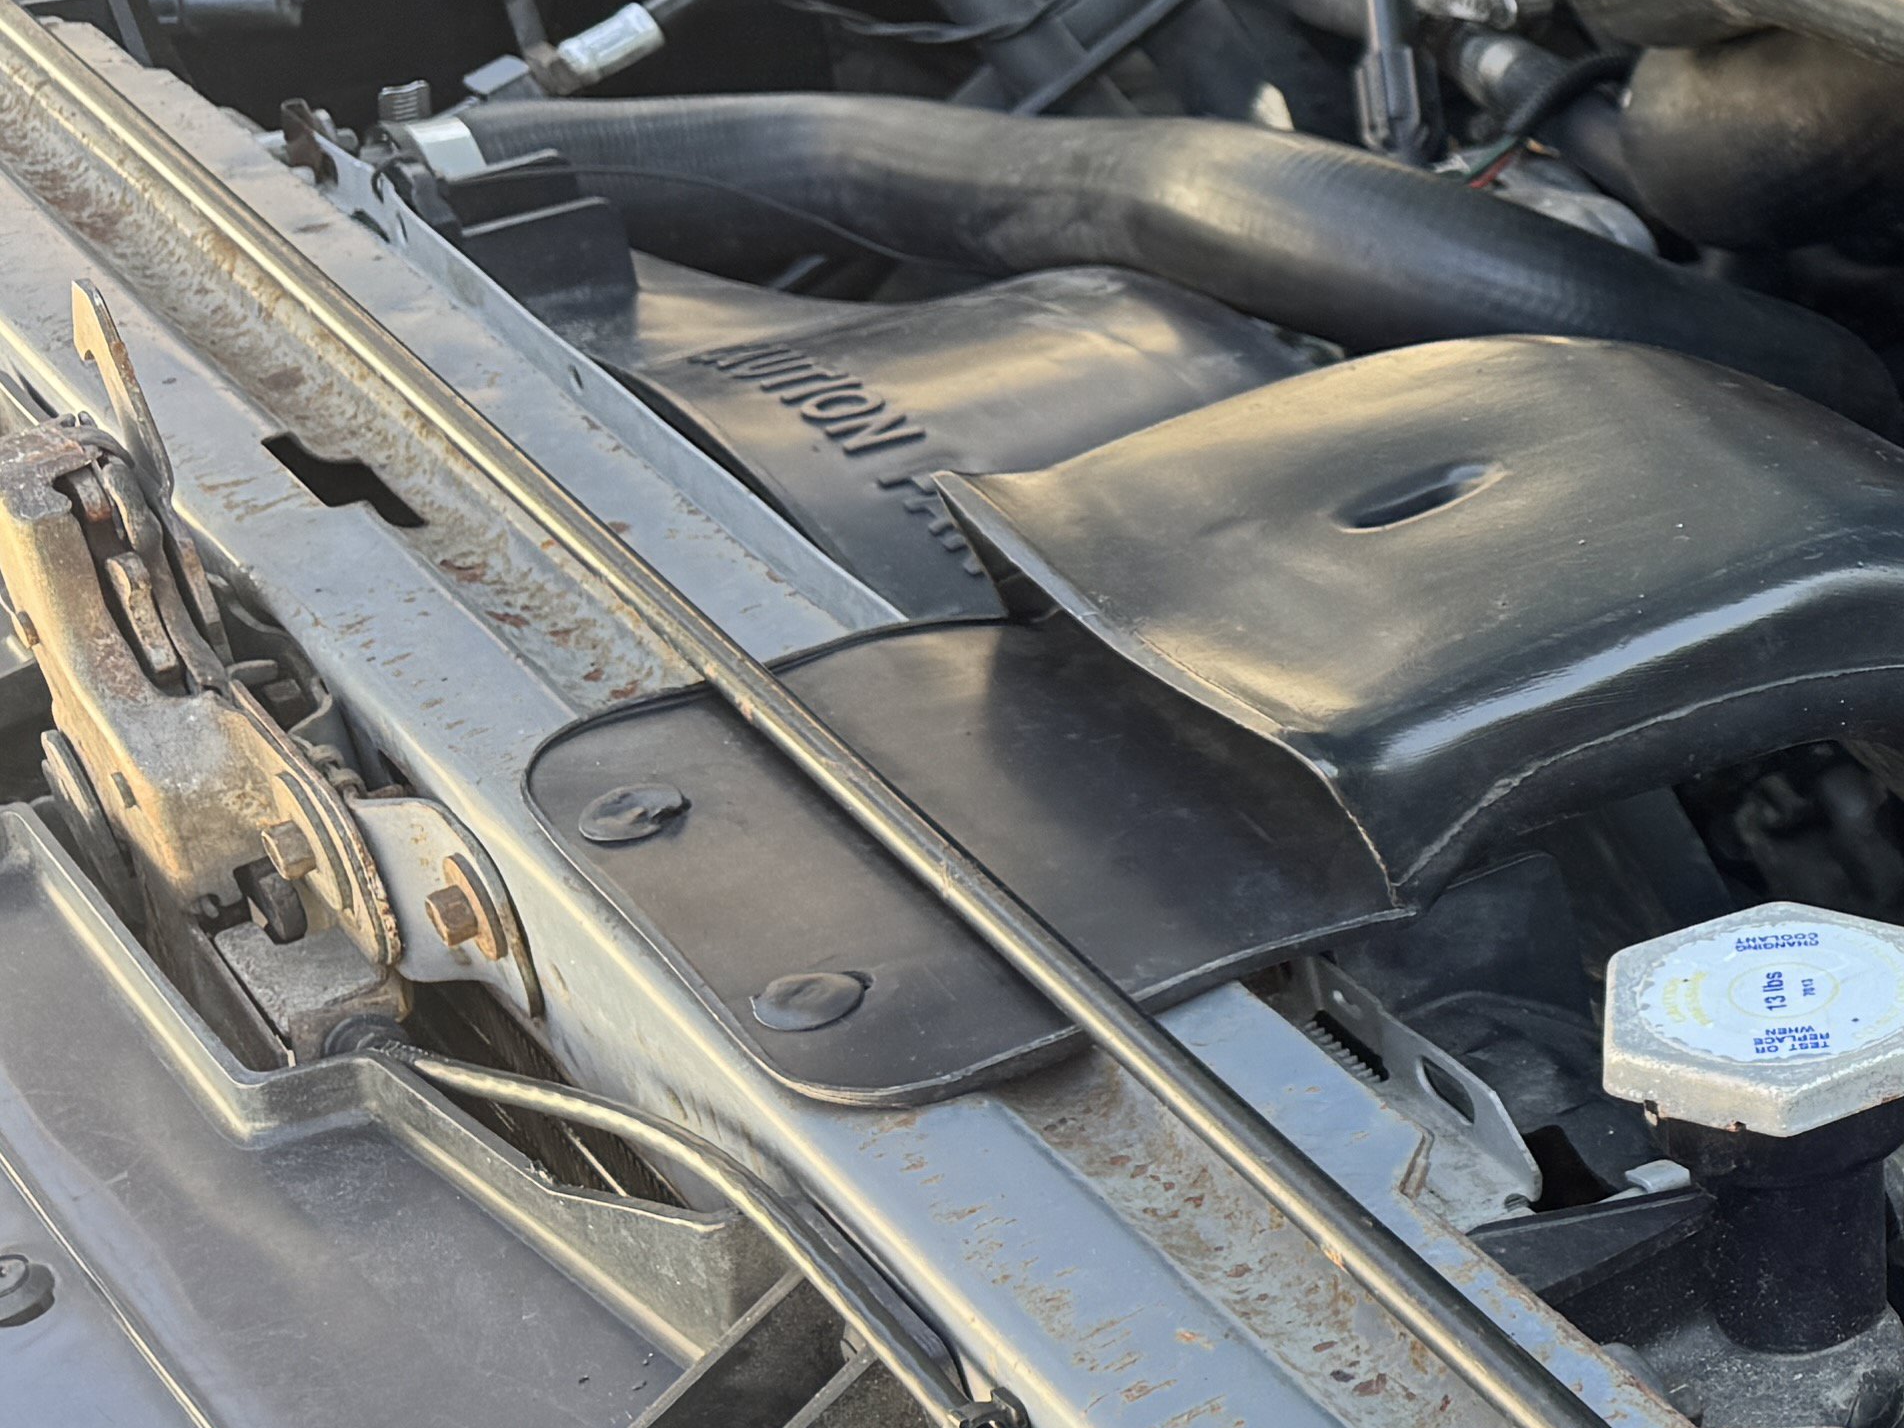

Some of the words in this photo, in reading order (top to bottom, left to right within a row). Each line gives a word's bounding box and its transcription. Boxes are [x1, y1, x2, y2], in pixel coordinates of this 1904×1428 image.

[686, 341, 927, 458] AUTION
[1735, 931, 1819, 945] COOLANT
[1761, 971, 1785, 993] lbs
[1763, 994, 1788, 1012] 13
[1765, 1025, 1815, 1036] WHEN
[1753, 1032, 1830, 1045] REPLACE
[1755, 1045, 1779, 1054] OR
[1789, 1041, 1830, 1051] TEST
